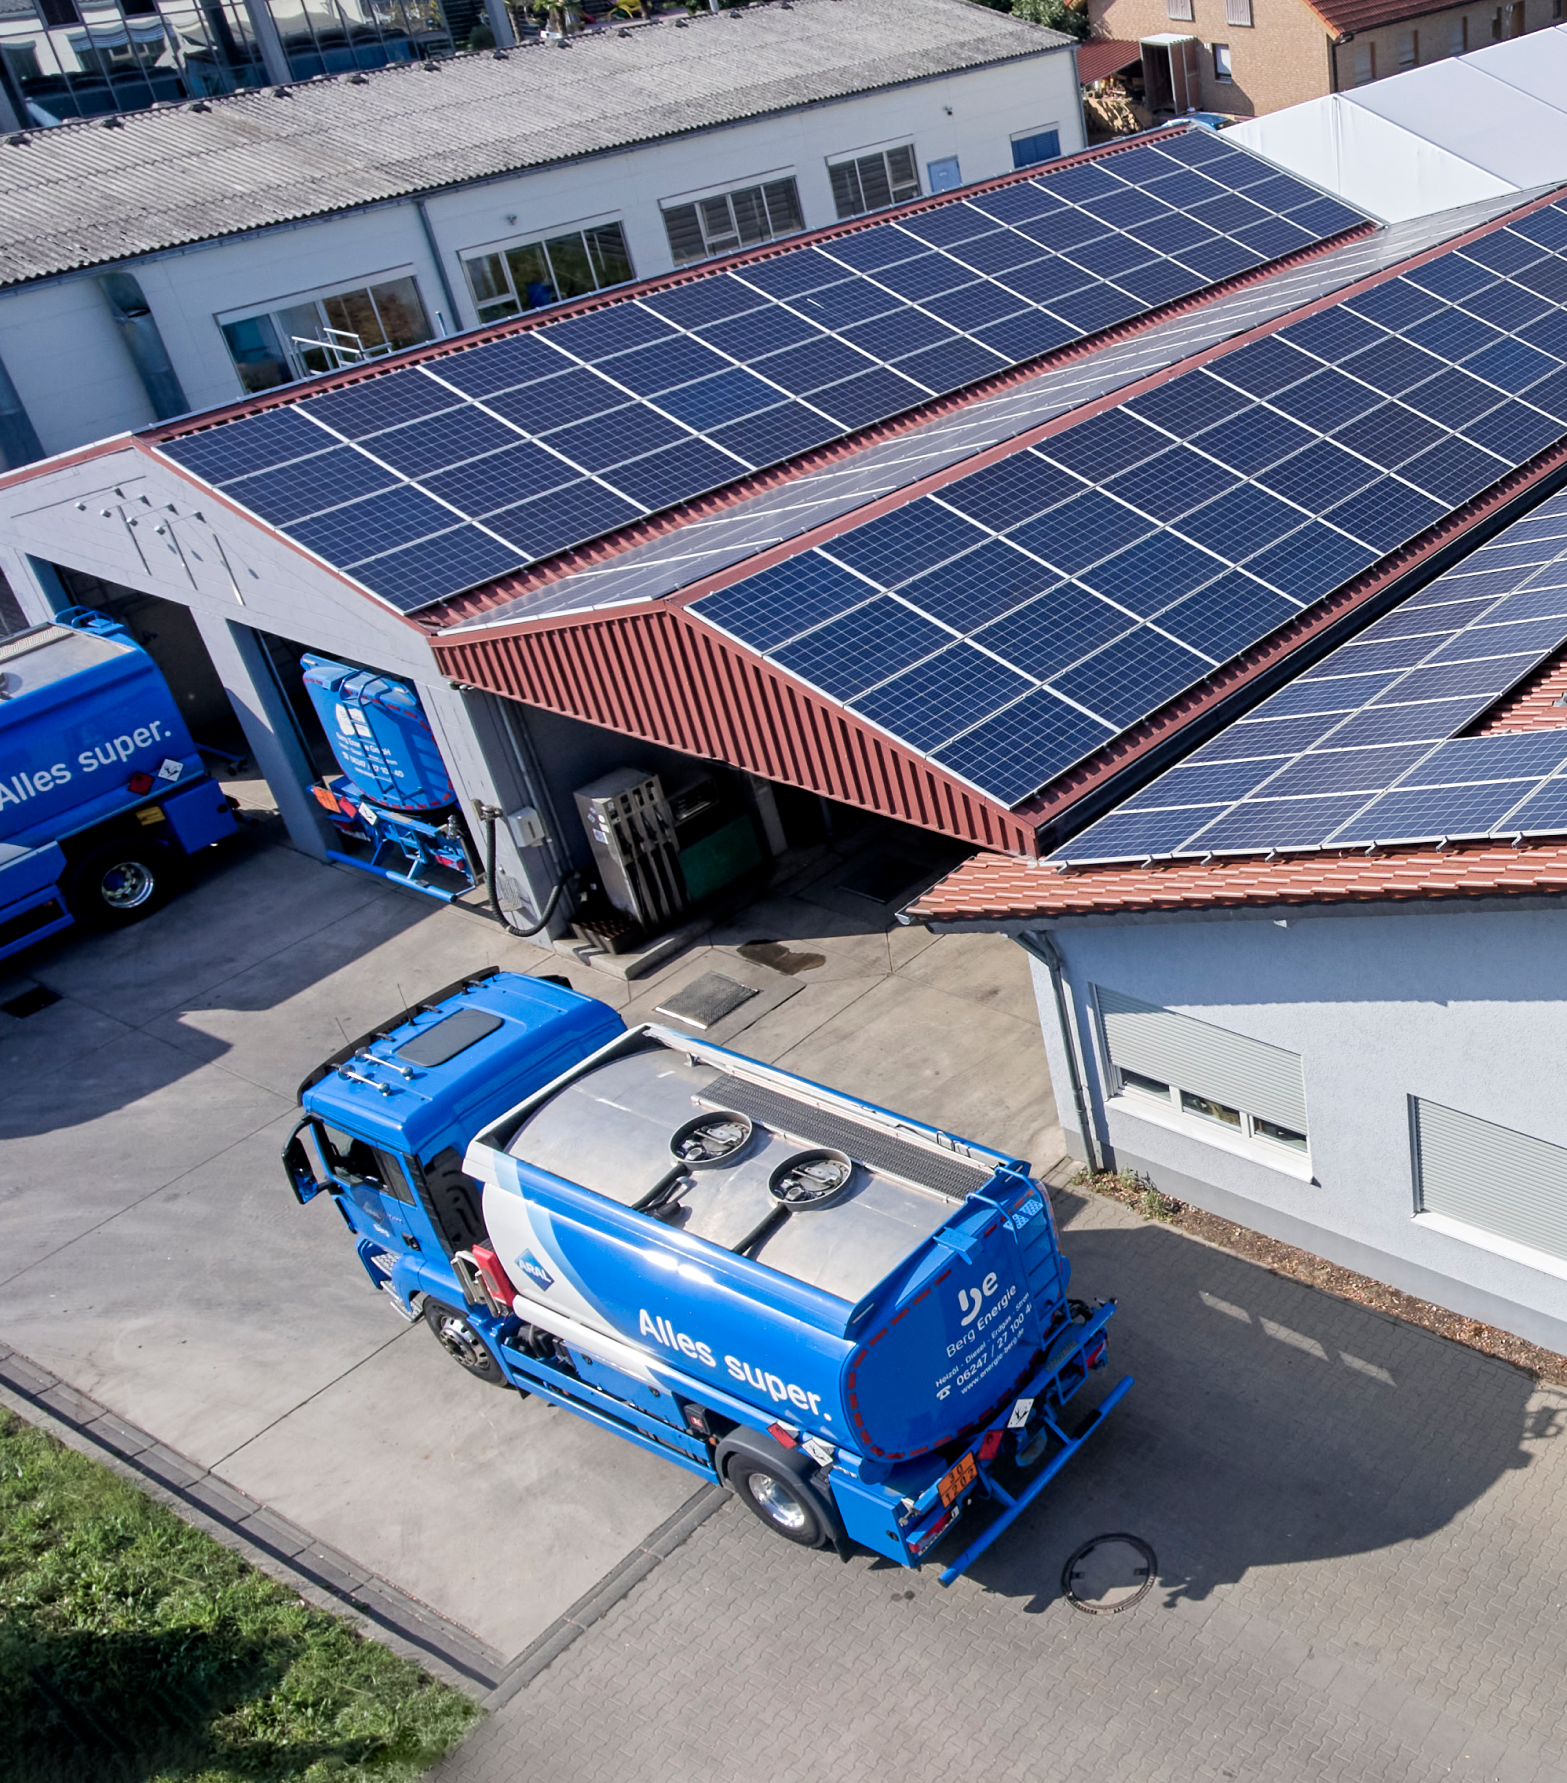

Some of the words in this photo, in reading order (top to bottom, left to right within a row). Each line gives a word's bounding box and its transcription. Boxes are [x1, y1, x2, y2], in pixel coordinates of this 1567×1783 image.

[0, 763, 72, 811] Alles
[78, 720, 171, 772] super.
[518, 1259, 552, 1283] ARAL
[935, 1366, 959, 1387] Heizöl
[965, 1342, 986, 1363] Diesel
[991, 1315, 1012, 1339] Erdgas
[946, 1329, 975, 1357] Berg
[977, 1285, 1016, 1330] Energie
[956, 1353, 987, 1386] 06247
[997, 1332, 1008, 1349] 27
[1010, 1313, 1024, 1333] 100
[639, 1308, 717, 1368] Alles
[724, 1355, 832, 1421] super.
[945, 1468, 975, 1502] 1202
[948, 1463, 963, 1484] 30
